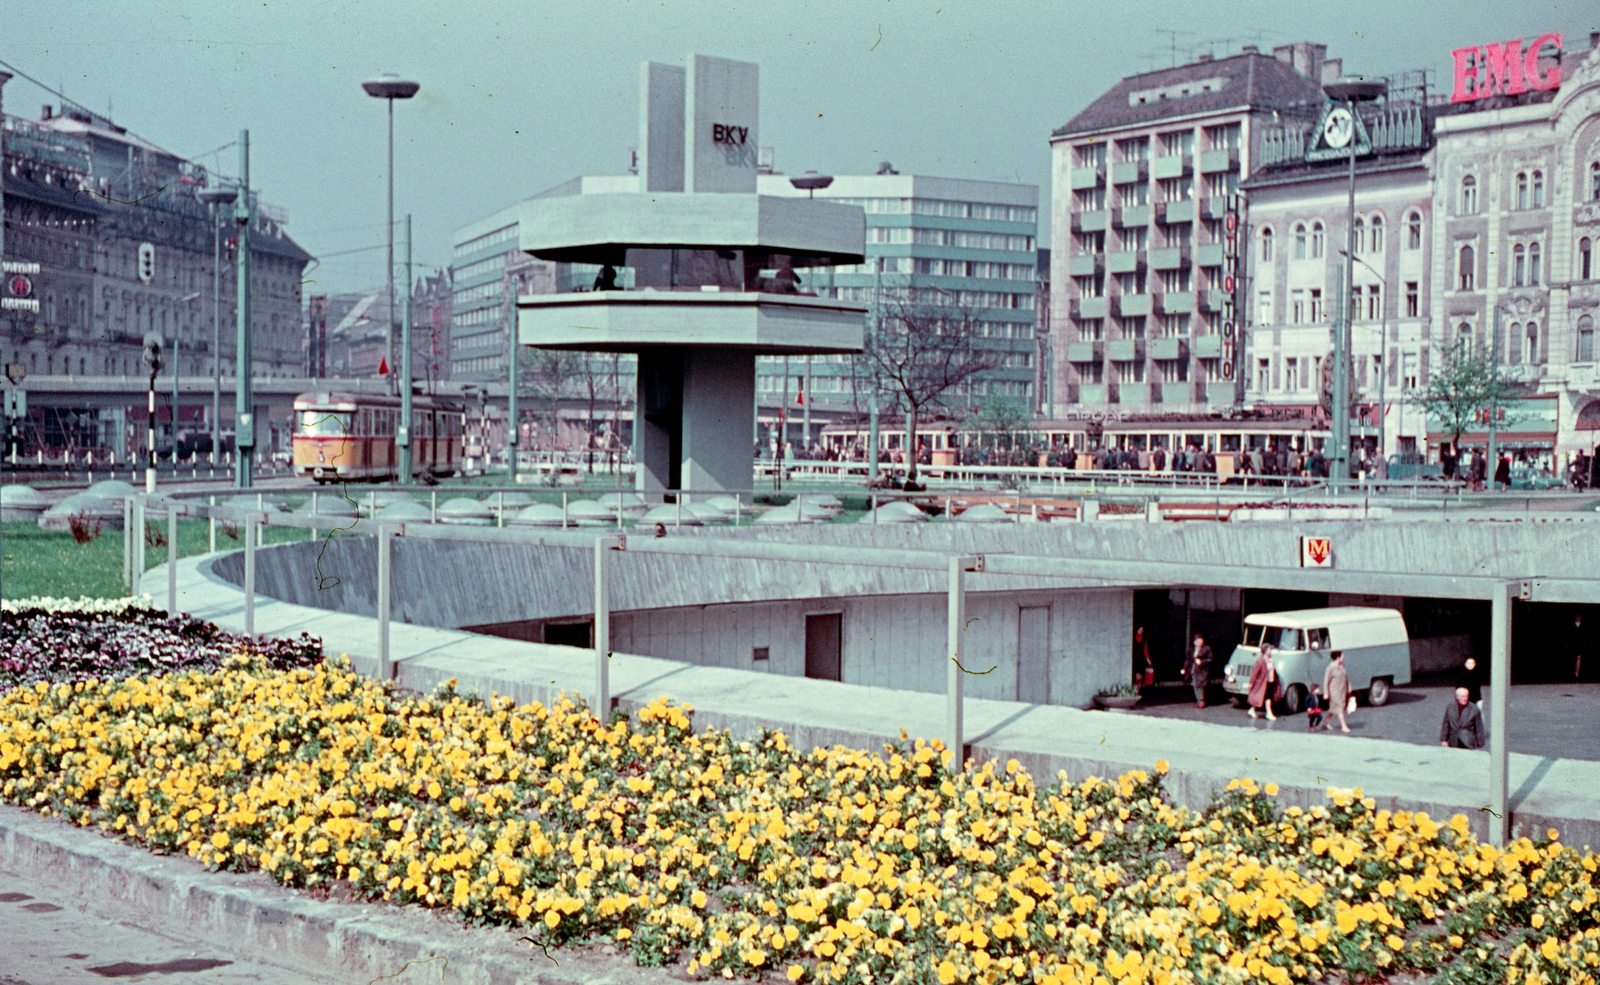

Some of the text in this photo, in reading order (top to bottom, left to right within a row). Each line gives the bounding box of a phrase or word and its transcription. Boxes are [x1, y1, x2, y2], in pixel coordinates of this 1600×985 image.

[1451, 33, 1562, 103] EMG
[713, 123, 748, 145] BKV
[1223, 195, 1236, 377] LOTTO TOTO
[1310, 540, 1329, 554] M
